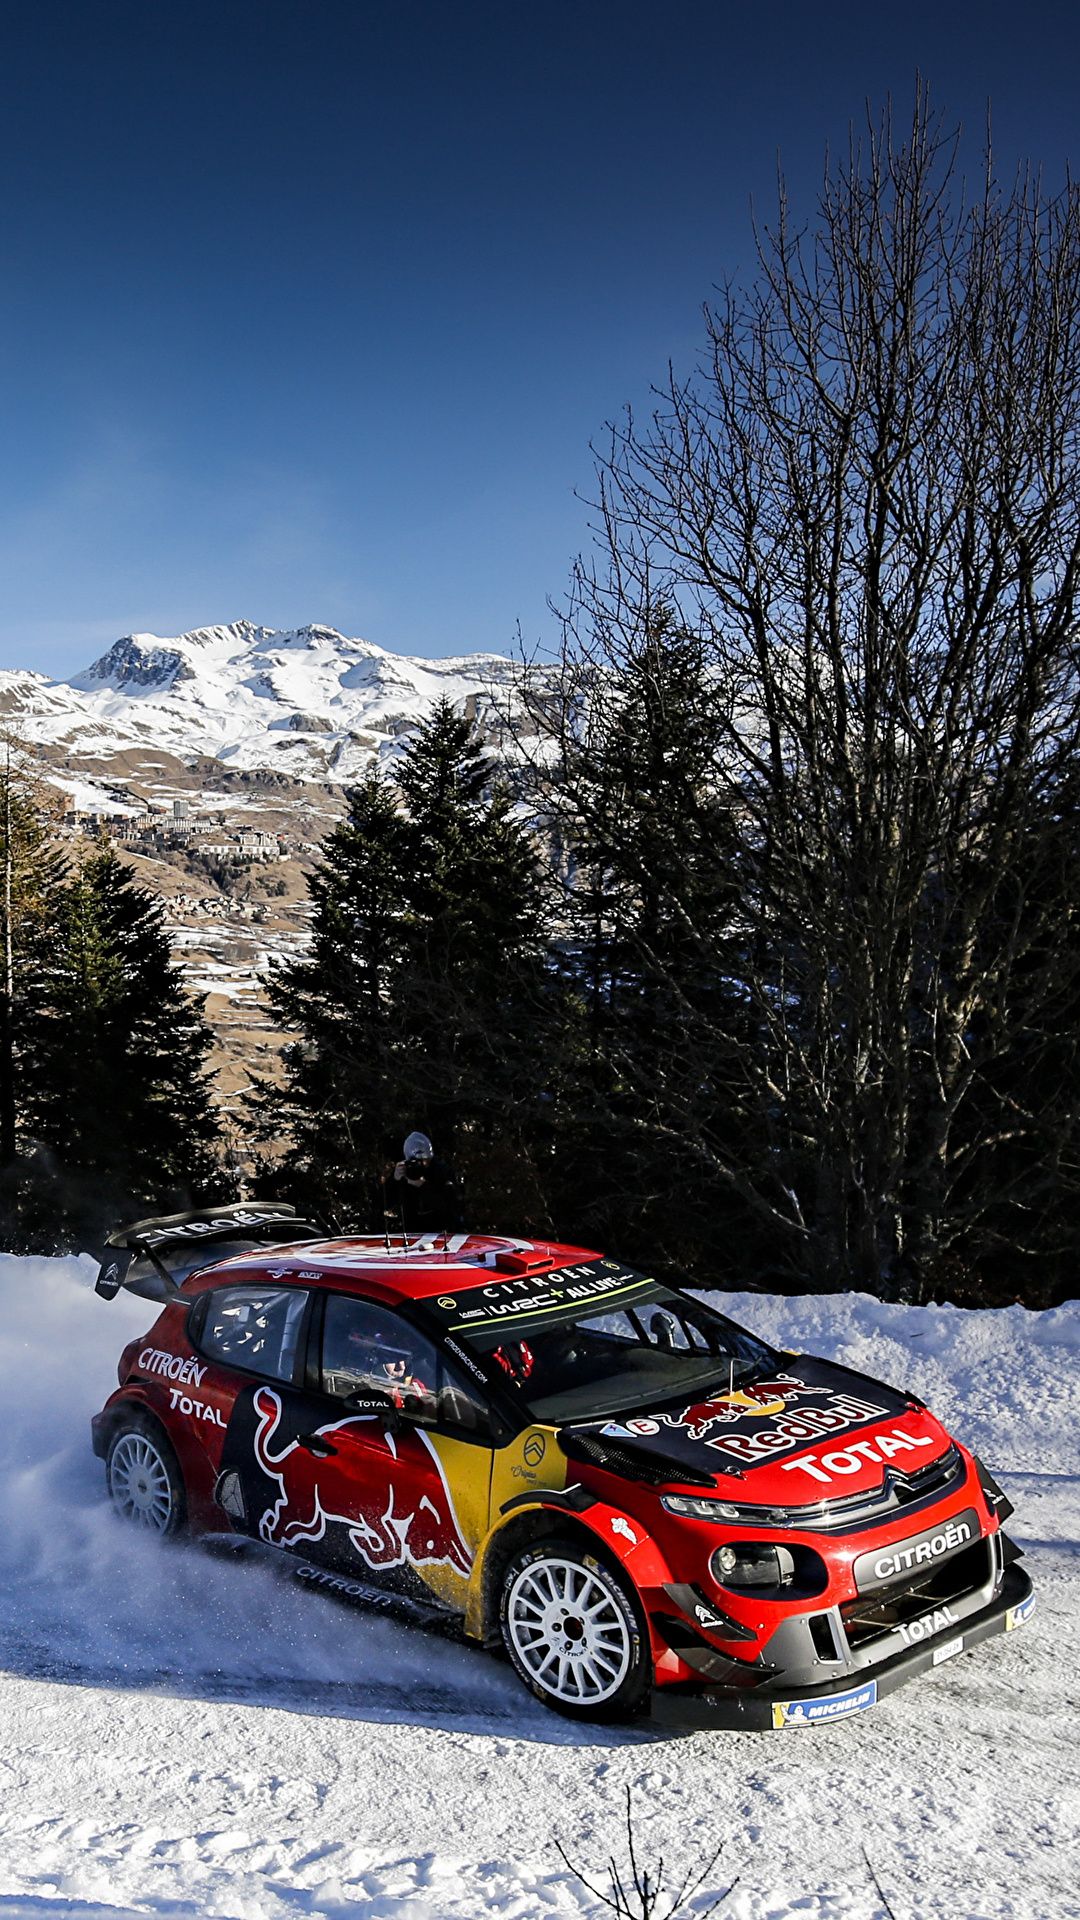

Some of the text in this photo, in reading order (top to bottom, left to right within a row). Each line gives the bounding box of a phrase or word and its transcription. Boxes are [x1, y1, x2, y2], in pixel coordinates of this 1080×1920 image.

[566, 1284, 597, 1299] ALL
[589, 1277, 622, 1291] LIVE
[138, 1347, 208, 1388] CITROËN
[169, 1387, 228, 1429] TOTAL
[357, 1399, 389, 1408] TOTAL
[781, 1429, 934, 1483] TOTAL
[601, 1571, 638, 1630] MICHELIN
[891, 1605, 960, 1645] TOTAL
[808, 1691, 871, 1718] MICHELIN
